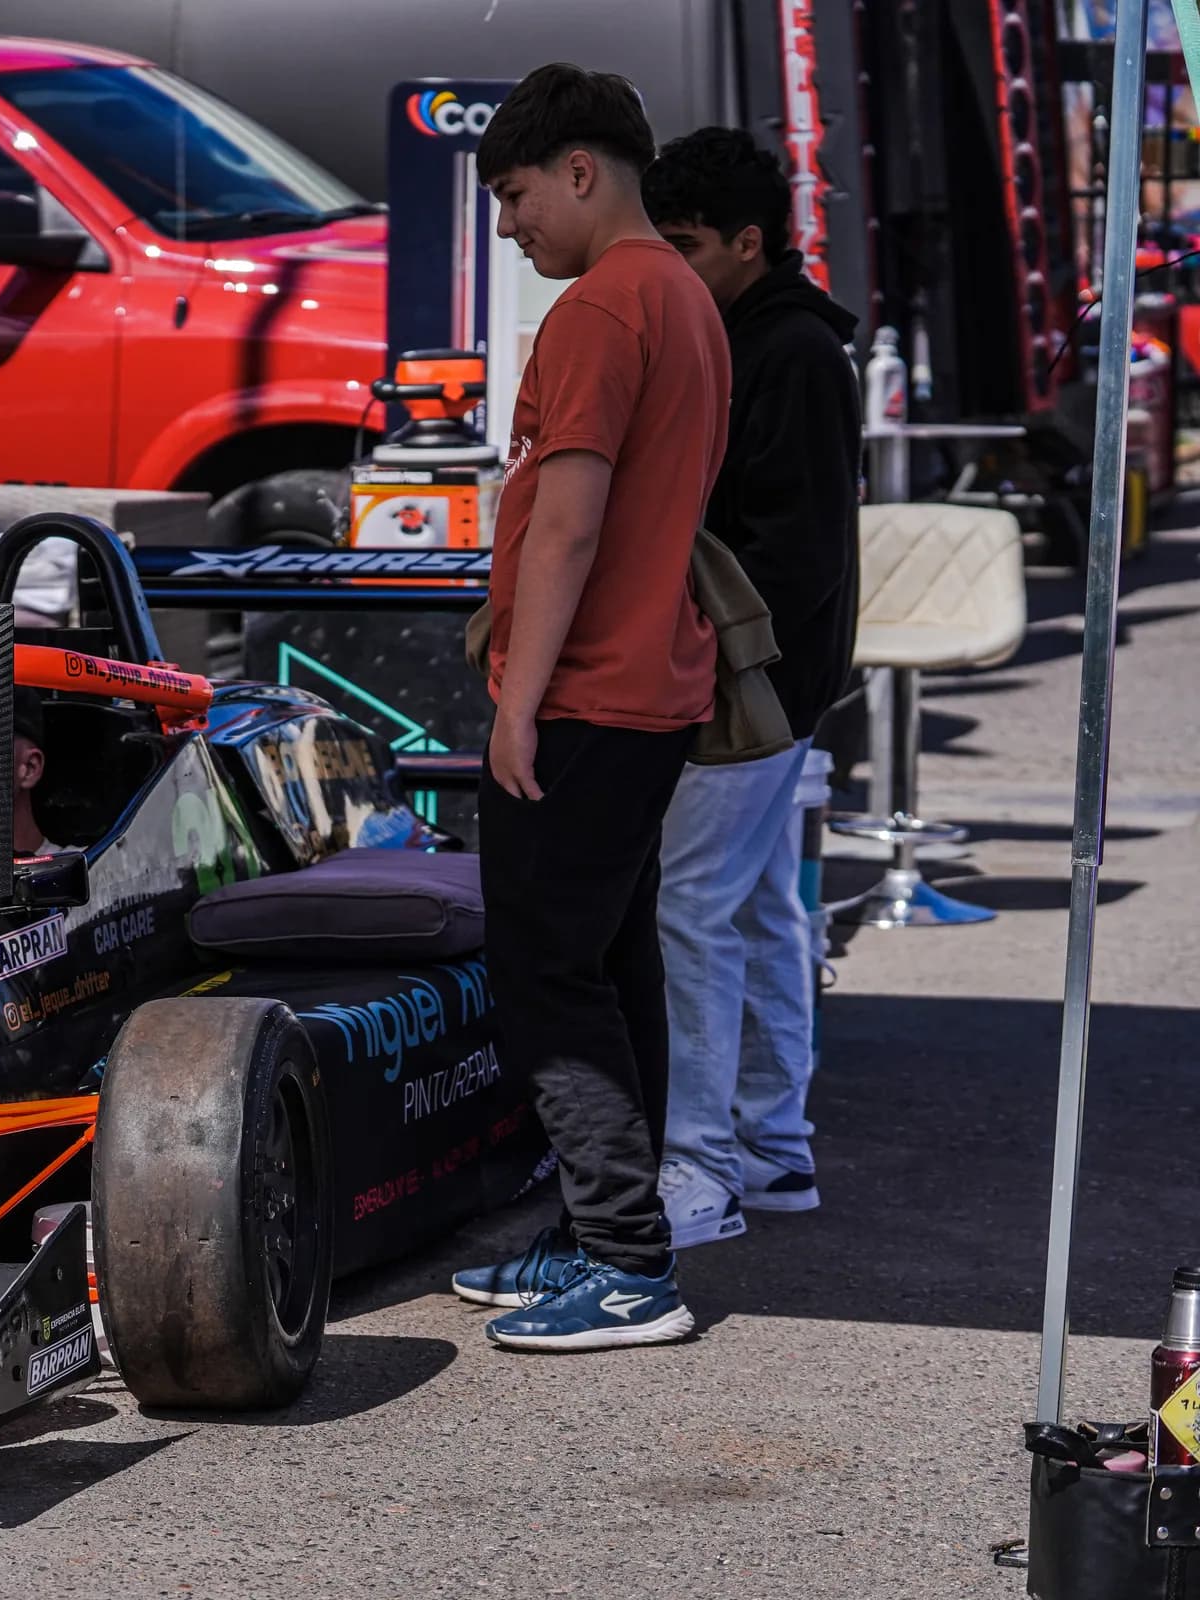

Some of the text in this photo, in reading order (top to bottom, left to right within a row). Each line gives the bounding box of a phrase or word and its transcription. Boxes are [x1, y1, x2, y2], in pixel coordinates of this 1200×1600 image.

[94, 907, 156, 955] CAR CARE
[297, 976, 447, 1083] Miguel
[404, 1041, 501, 1124] PINTURERIA
[31, 1332, 89, 1386] BARPRAN
